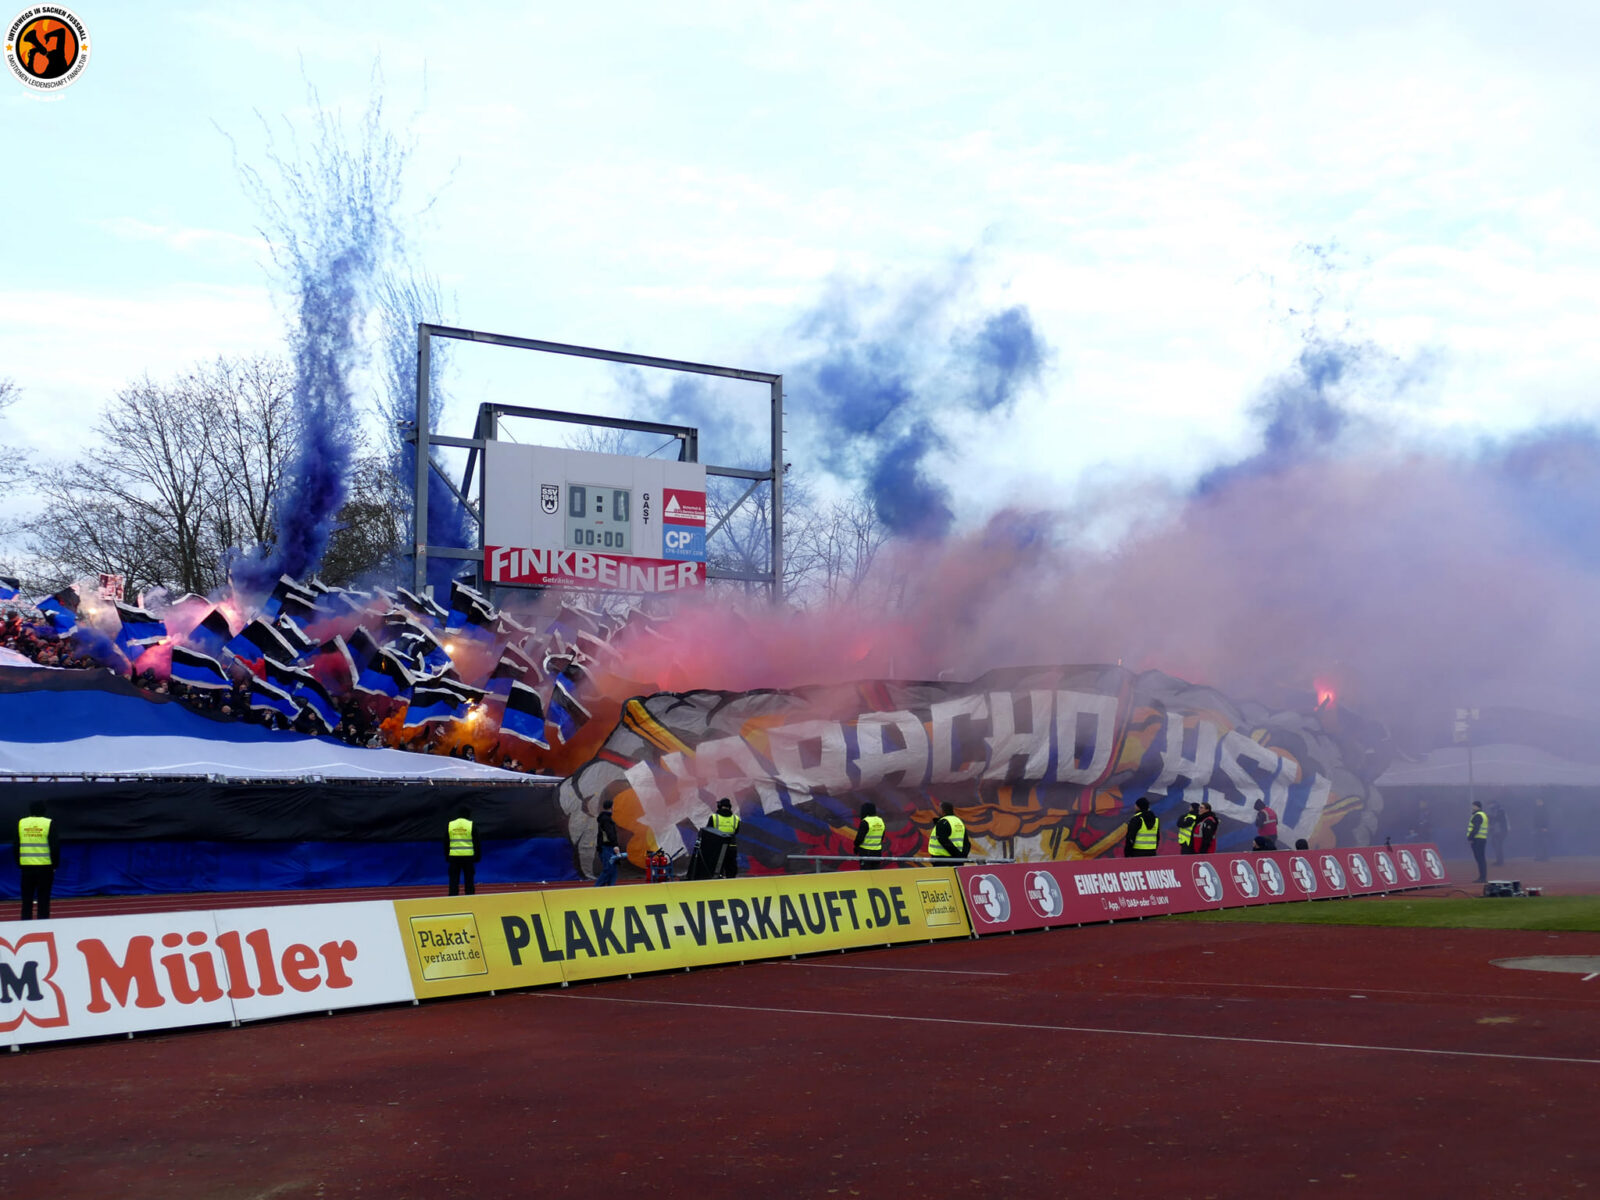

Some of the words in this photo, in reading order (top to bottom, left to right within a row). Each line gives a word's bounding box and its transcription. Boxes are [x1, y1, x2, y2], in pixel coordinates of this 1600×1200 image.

[491, 545, 699, 593] FINKBEINER
[542, 576, 575, 585] Getränke
[921, 890, 952, 903] Plakat-
[1034, 876, 1054, 912] 3
[1074, 873, 1121, 895] EINFACH
[1119, 871, 1148, 892] GUTE
[1145, 869, 1181, 889] MUSIK.
[1199, 866, 1216, 898] 3
[978, 879, 1001, 918] 3
[417, 928, 476, 948] Plakat-
[501, 886, 911, 966] PLAKAT-VERKAUFT.DE
[76, 928, 358, 1014] Müller
[424, 949, 481, 964] verkauft.de
